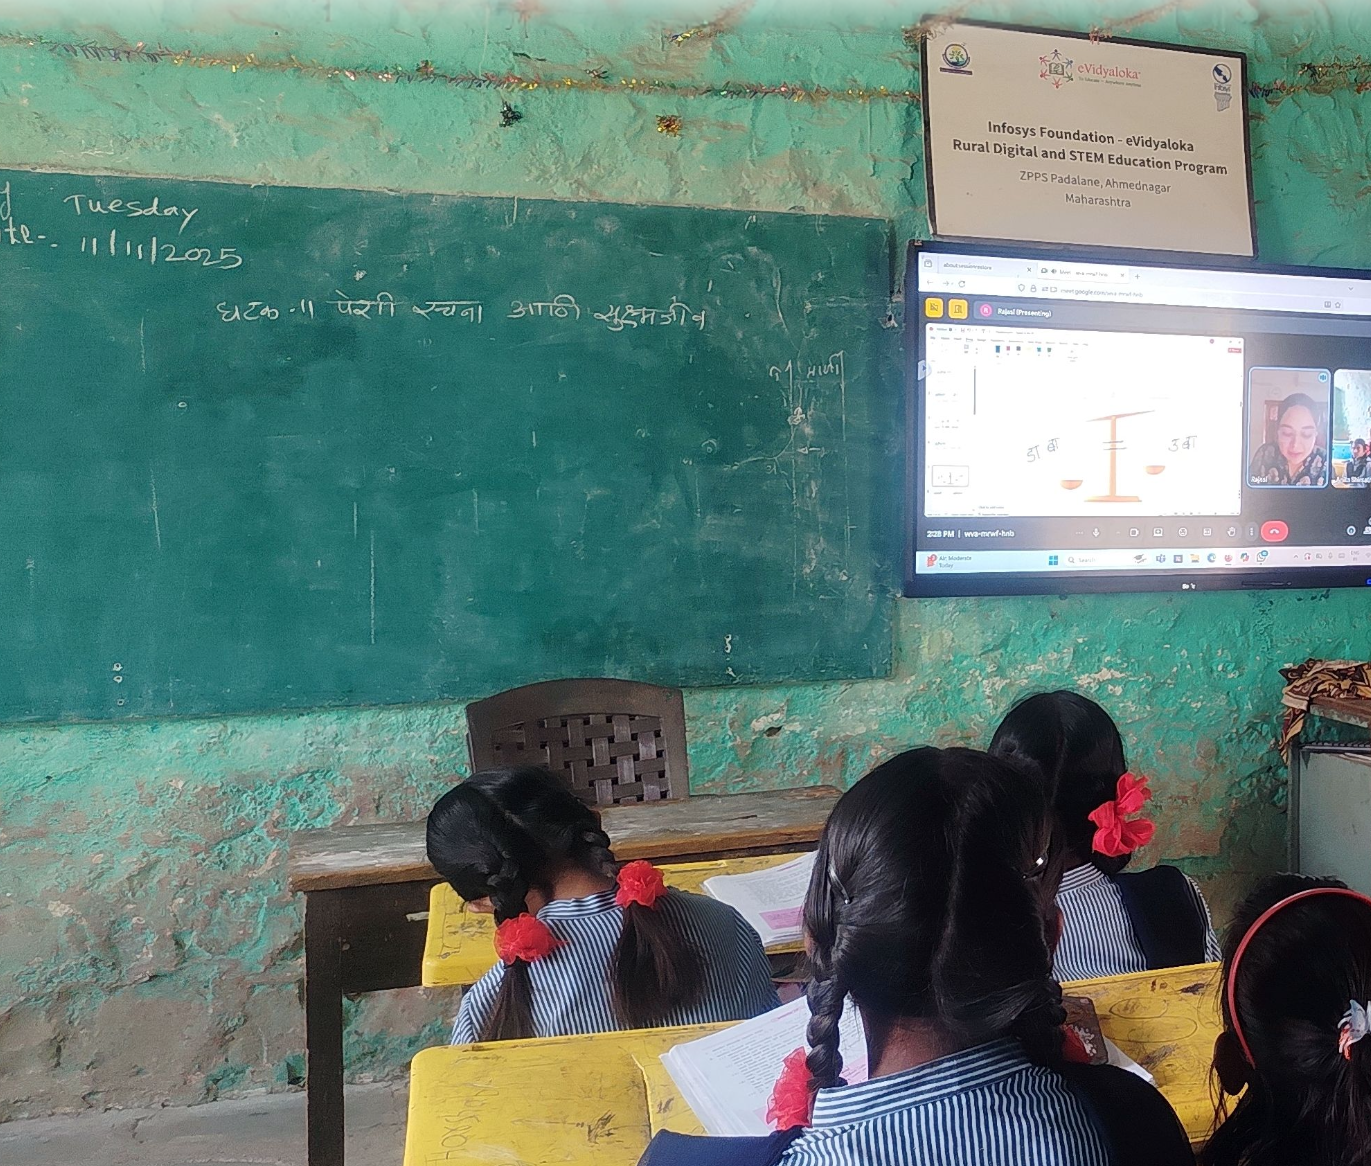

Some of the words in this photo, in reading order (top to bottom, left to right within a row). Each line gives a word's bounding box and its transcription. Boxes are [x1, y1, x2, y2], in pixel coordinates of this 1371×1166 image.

[1077, 63, 1139, 80] eVidyaloka
[988, 120, 1037, 139] Infosys
[1039, 126, 1115, 146] Foundation
[1126, 135, 1195, 153] eVidyaloka
[953, 138, 990, 154] Rural
[993, 142, 1039, 161] Digital
[1041, 146, 1066, 161] and
[1069, 149, 1105, 165] STEM
[1108, 152, 1172, 170] Education
[1174, 160, 1228, 176] Program
[1019, 170, 1048, 183] ZPPS
[1050, 172, 1104, 190] Padalane,
[1105, 178, 1172, 195] Ahmednagar
[64, 194, 199, 235] Tuesday
[1065, 193, 1132, 209] Maharashtra
[81, 228, 243, 270] 11/11/2025
[943, 530, 955, 538] PM
